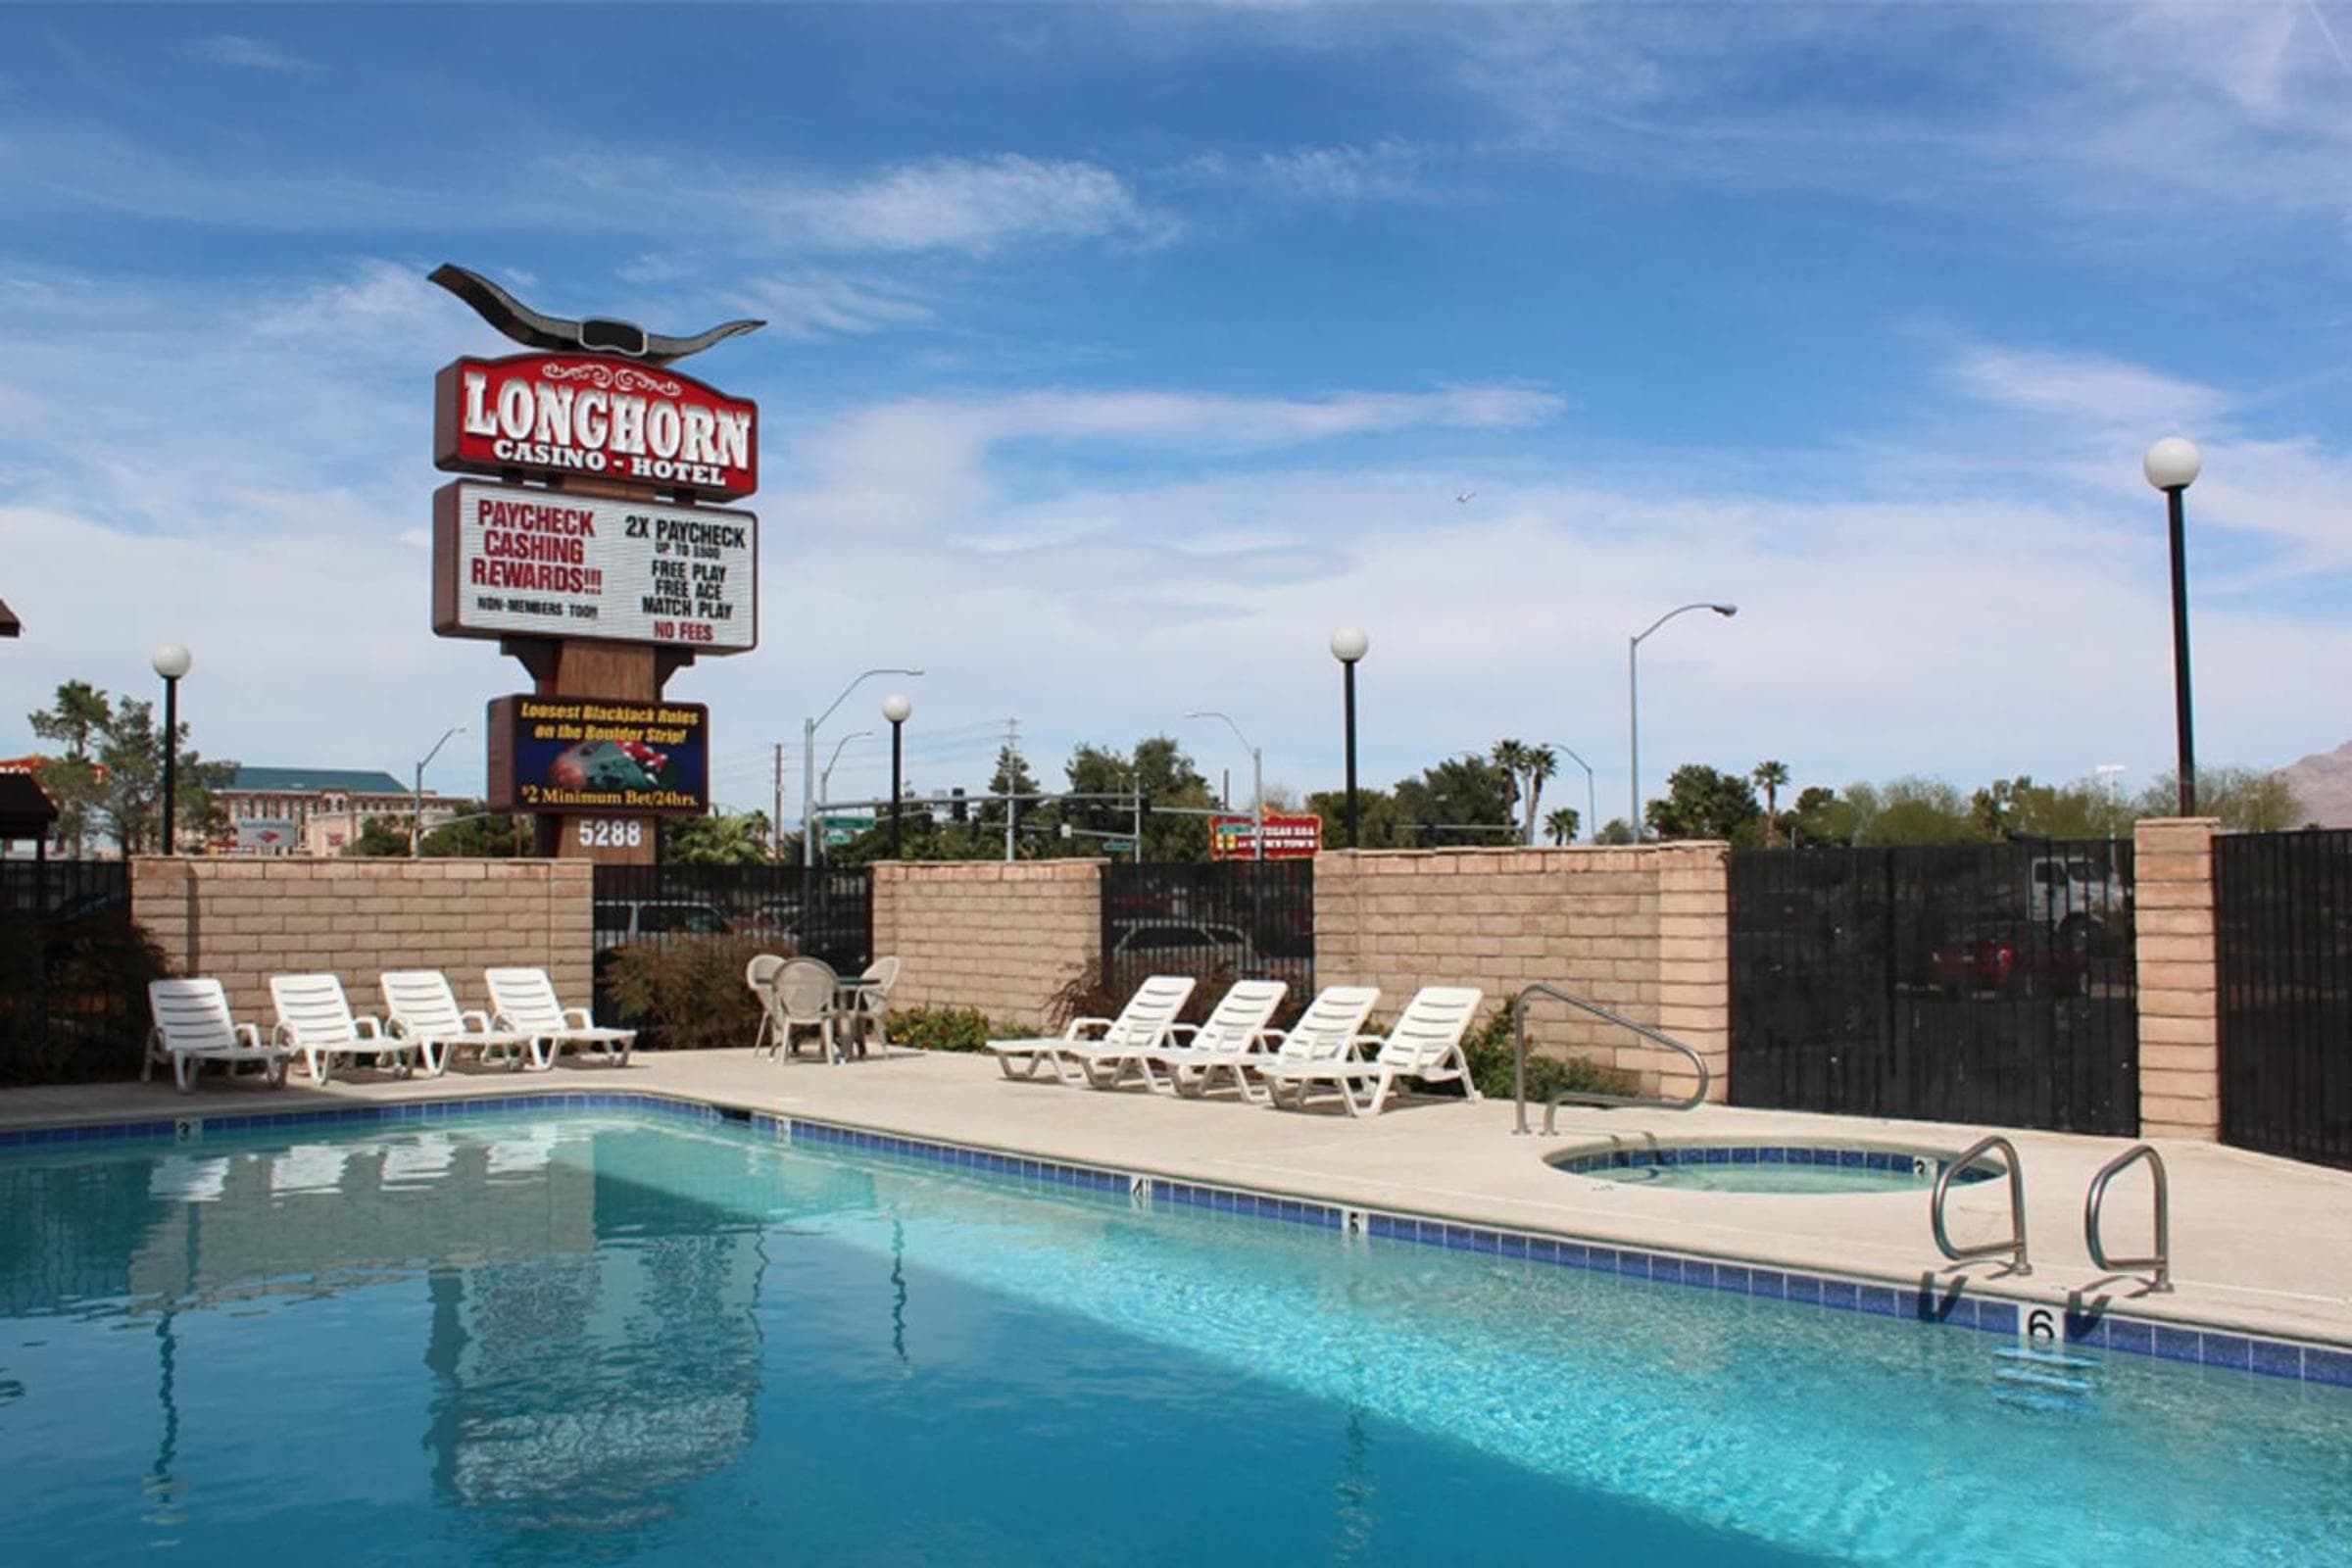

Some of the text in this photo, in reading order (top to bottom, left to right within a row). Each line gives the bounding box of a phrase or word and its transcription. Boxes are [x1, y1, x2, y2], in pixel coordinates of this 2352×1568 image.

[464, 372, 752, 469] LONGHORN
[494, 439, 606, 470] CASINO
[632, 458, 726, 486] HOTEL
[478, 500, 595, 537] PAYCHECK
[625, 515, 746, 548] 2X PAYCHECK
[484, 529, 584, 564] CASHING
[655, 541, 669, 554] UP
[675, 543, 689, 557] TO
[472, 558, 602, 595] REWARDS!!!
[652, 560, 727, 583] FREE PLAY
[656, 579, 722, 601] FREE ACE
[643, 596, 733, 619] MATCH PLAY
[655, 621, 713, 641] NO FEES
[658, 709, 698, 725] Rules
[534, 725, 555, 739] on
[557, 724, 582, 740] the
[584, 724, 643, 742] Boulder
[521, 785, 539, 804] $2
[542, 788, 621, 805] Minimum
[579, 820, 642, 847] 5288
[2029, 1309, 2054, 1340] 6
